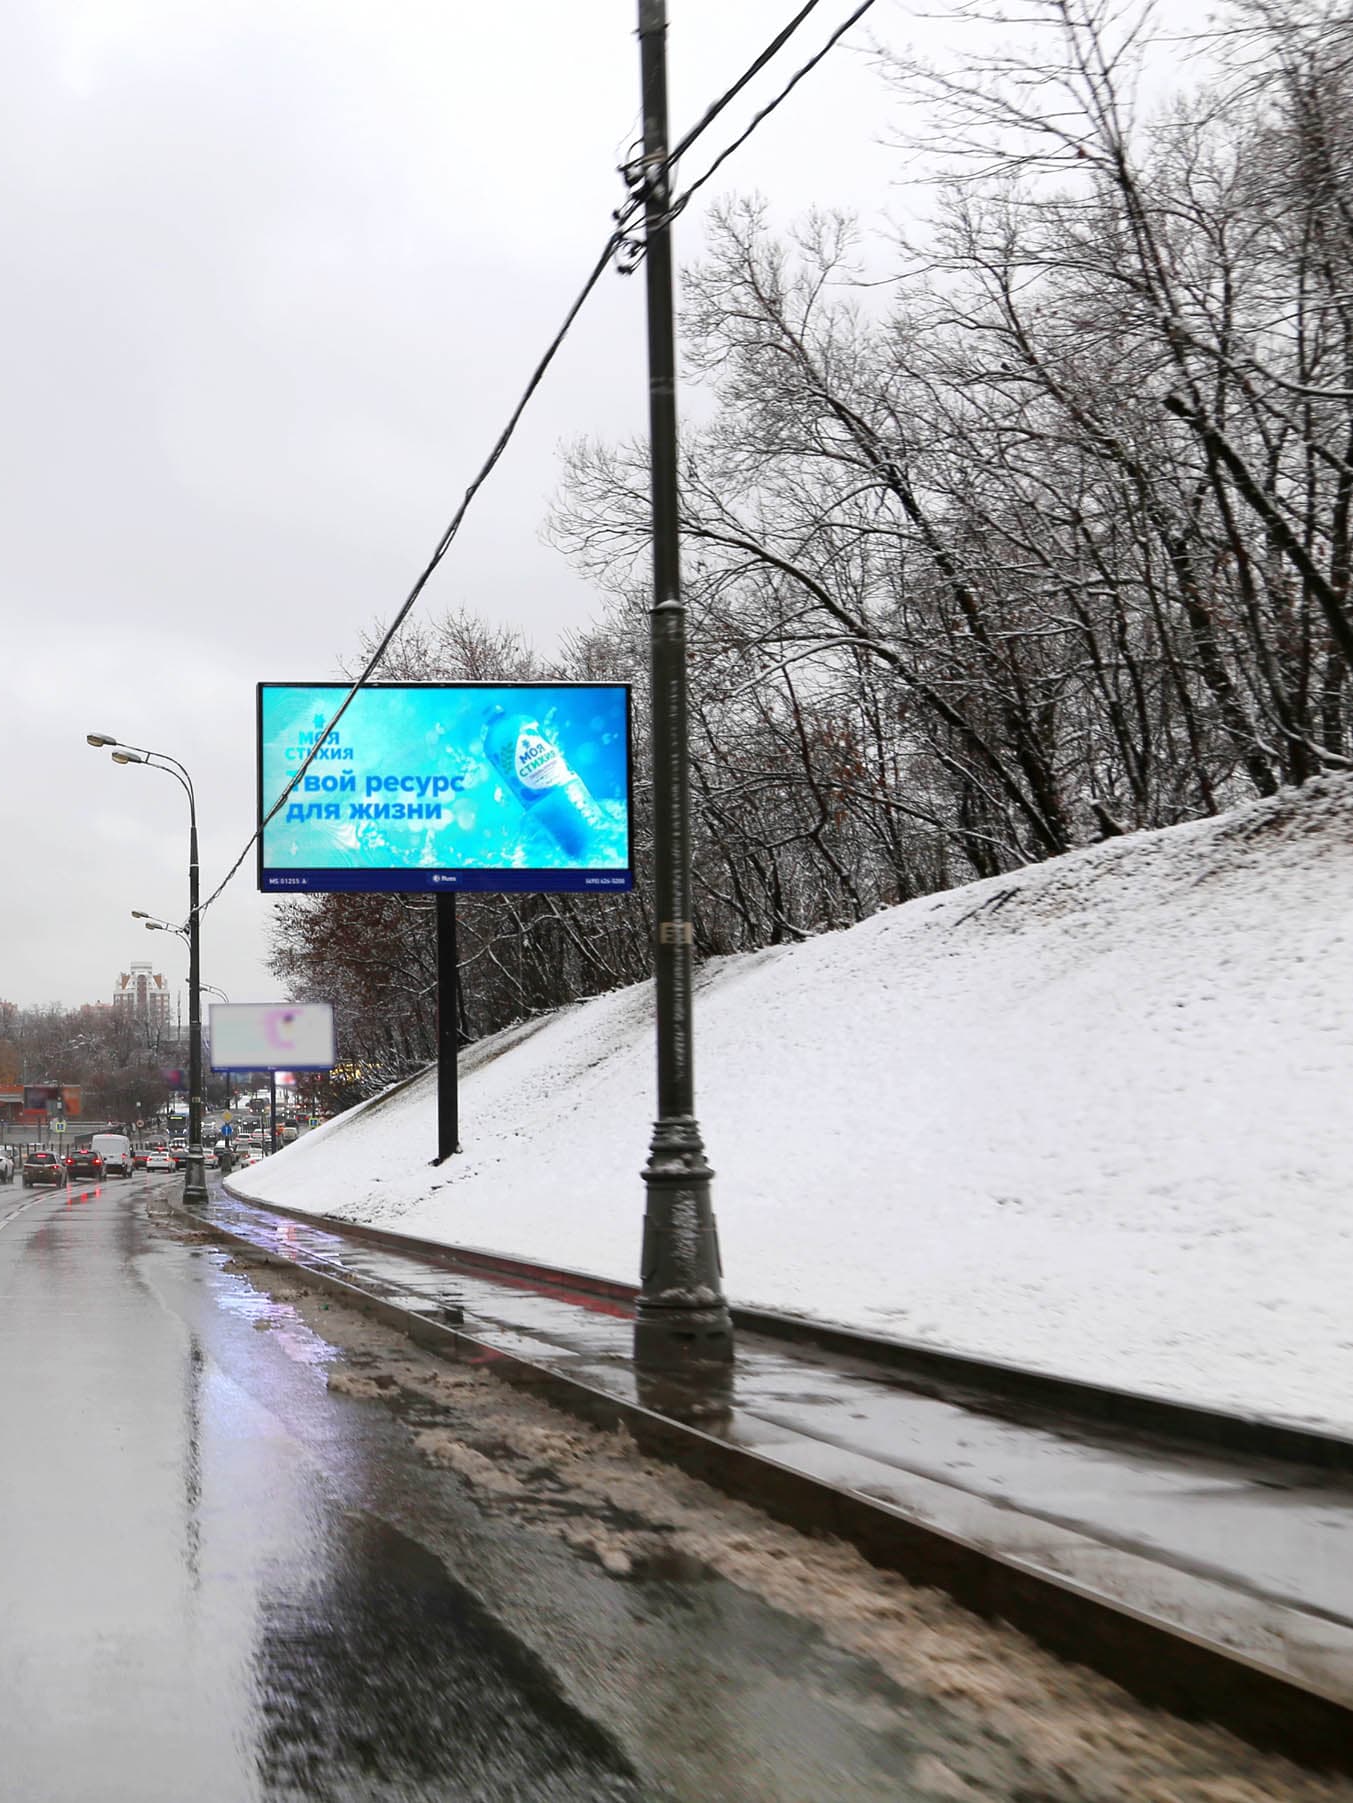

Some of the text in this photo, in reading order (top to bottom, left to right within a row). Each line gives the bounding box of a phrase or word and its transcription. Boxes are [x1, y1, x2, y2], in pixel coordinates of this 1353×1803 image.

[519, 743, 545, 764] МОЯ
[519, 750, 556, 777] СТИХИЯ
[365, 774, 465, 797] ресурс
[285, 802, 442, 823] для жизни
